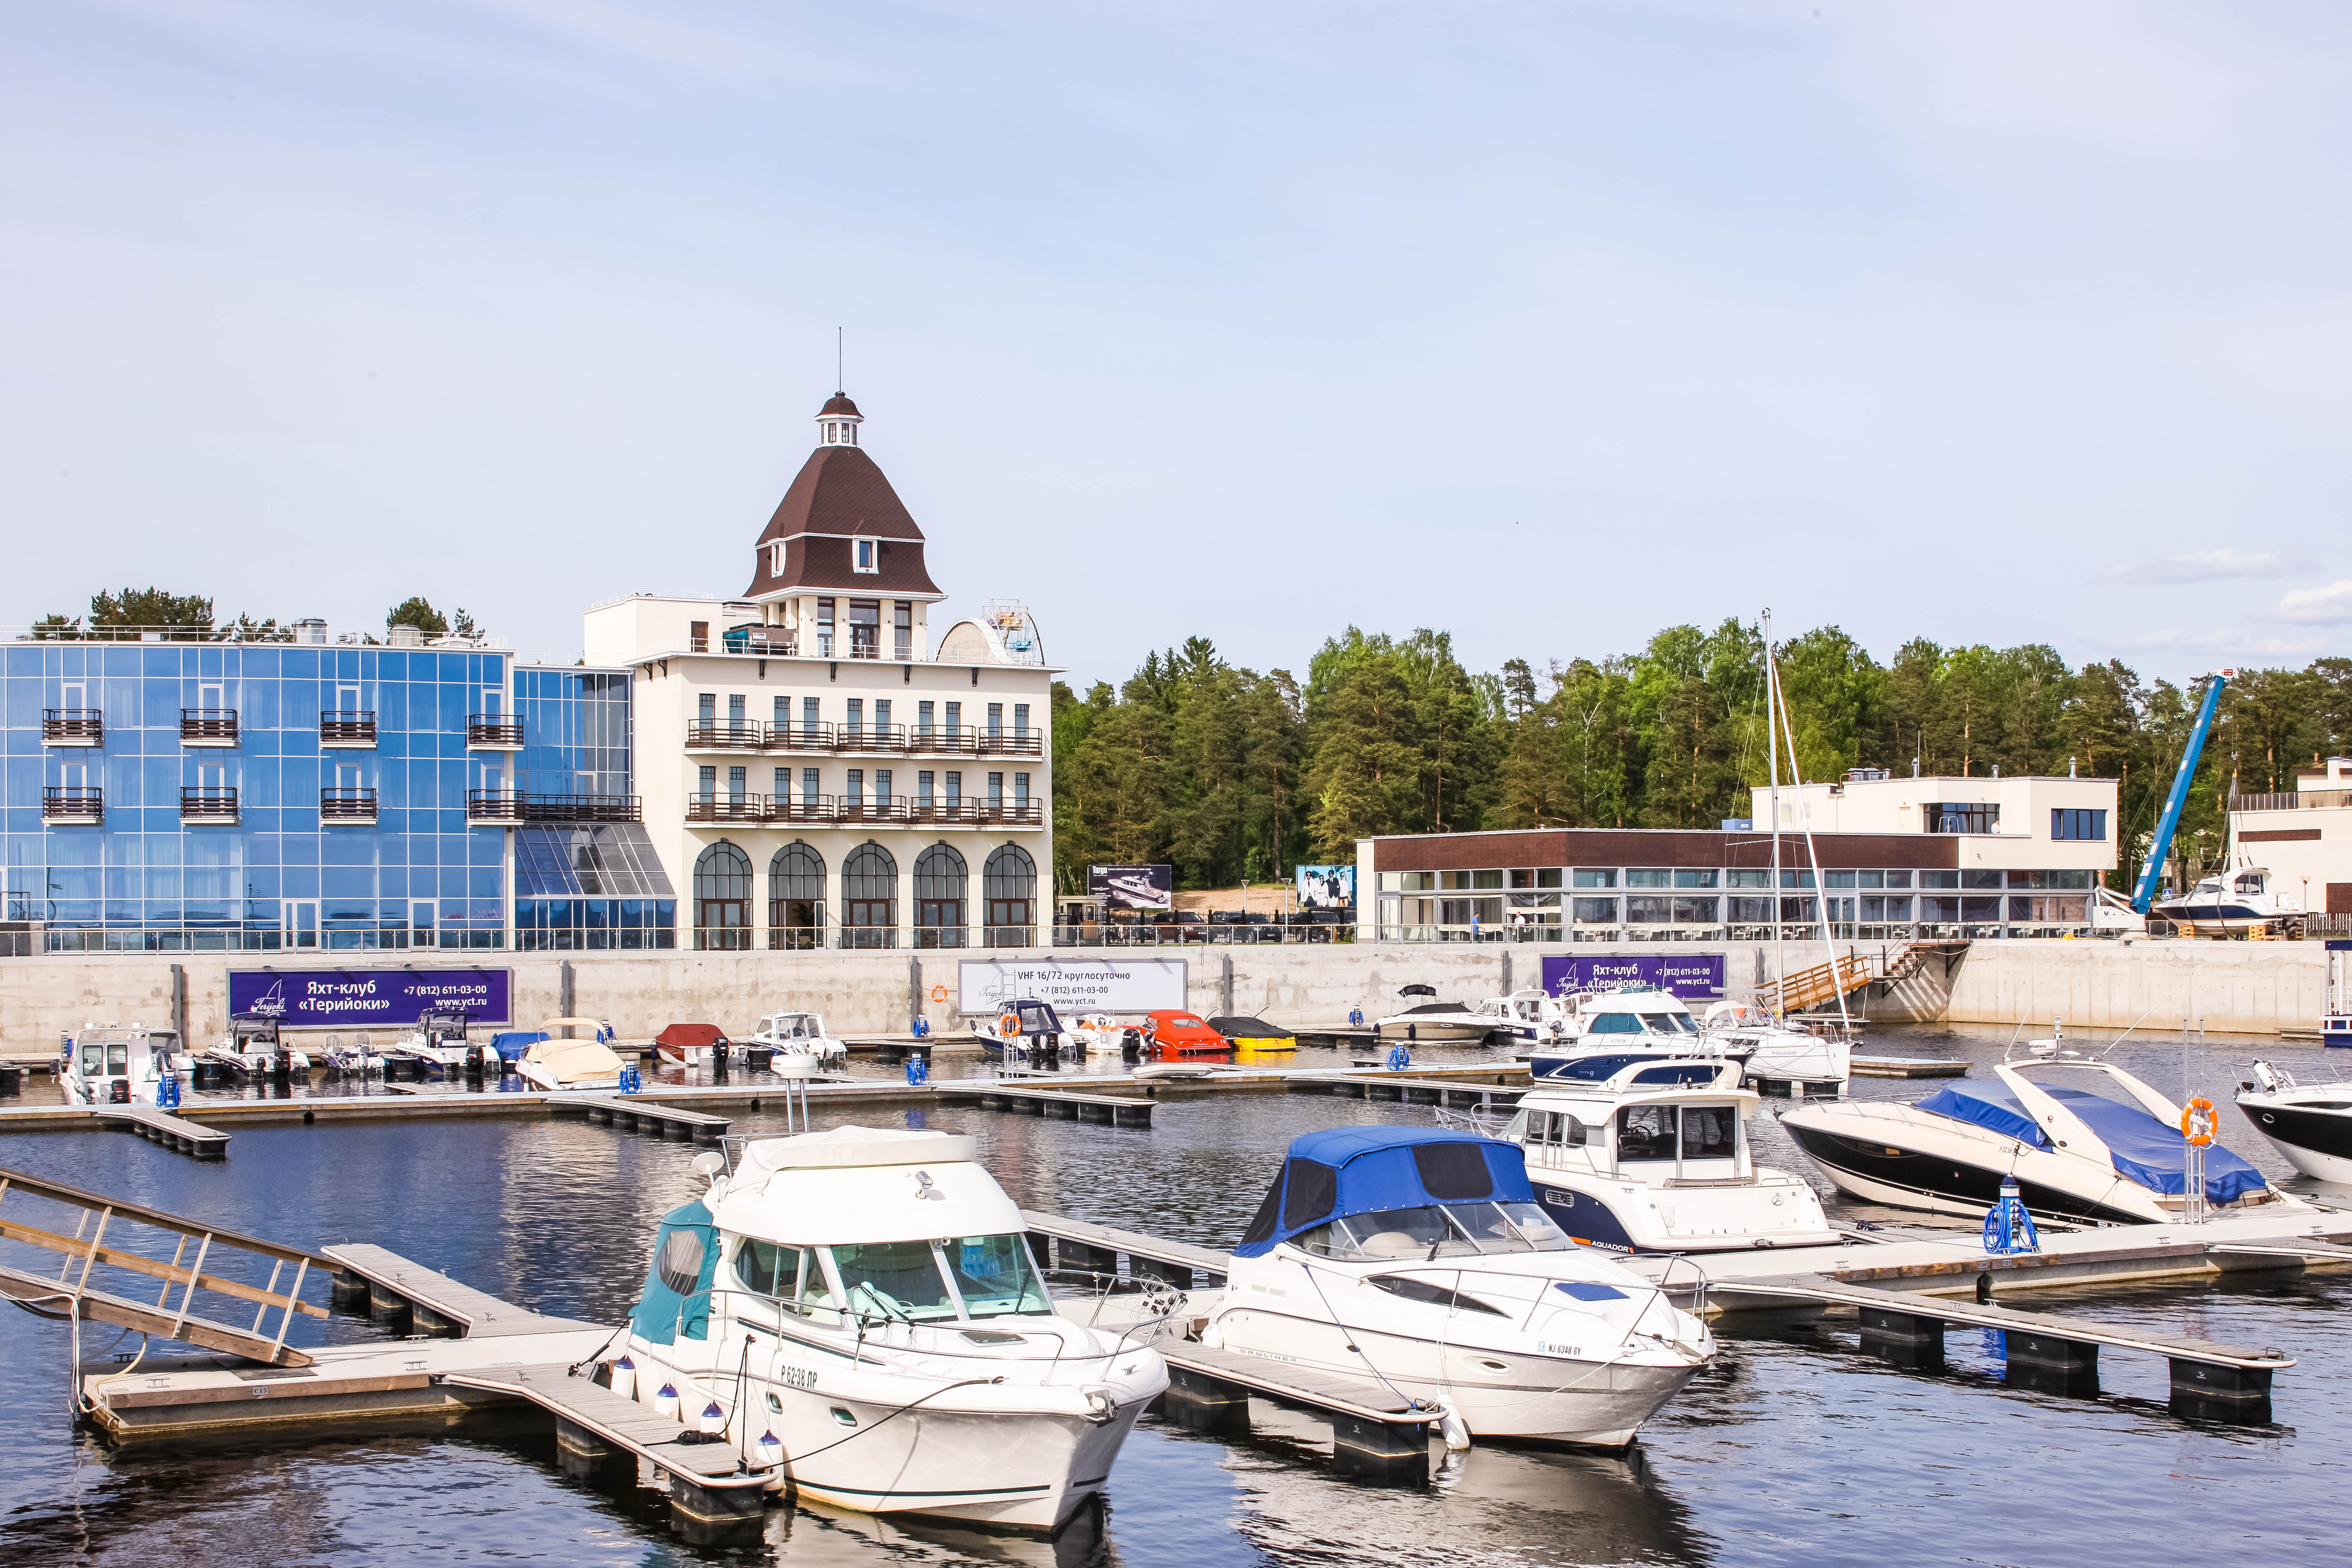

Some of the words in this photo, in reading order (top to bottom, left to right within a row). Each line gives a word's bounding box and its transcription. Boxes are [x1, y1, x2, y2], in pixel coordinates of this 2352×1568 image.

[1018, 971, 1034, 980] VHF
[1037, 970, 1062, 981] 16/72
[1065, 972, 1130, 981] круглосуточно
[1593, 963, 1638, 977] Яхт-клуб
[1664, 968, 1679, 977] (812)
[307, 980, 376, 997] Яхт-клуб
[1587, 977, 1647, 989] «Терийоки»
[404, 986, 415, 995] +7
[417, 985, 440, 996] (812)
[442, 985, 487, 994] 611-03-00
[1051, 986, 1070, 995] (812)
[1072, 986, 1108, 994] 611-03-00
[298, 997, 390, 1014] «Терийоки»
[435, 997, 487, 1007] www.yct.ru
[1053, 997, 1096, 1006] www.yct.ru
[1591, 1240, 1629, 1253] AQUADOR
[1240, 1349, 1297, 1363] BAYLINER
[1548, 1344, 1556, 1353] NJ
[1557, 1345, 1572, 1355] 6348
[1573, 1347, 1581, 1356] GY
[787, 1365, 805, 1387] 62-38
